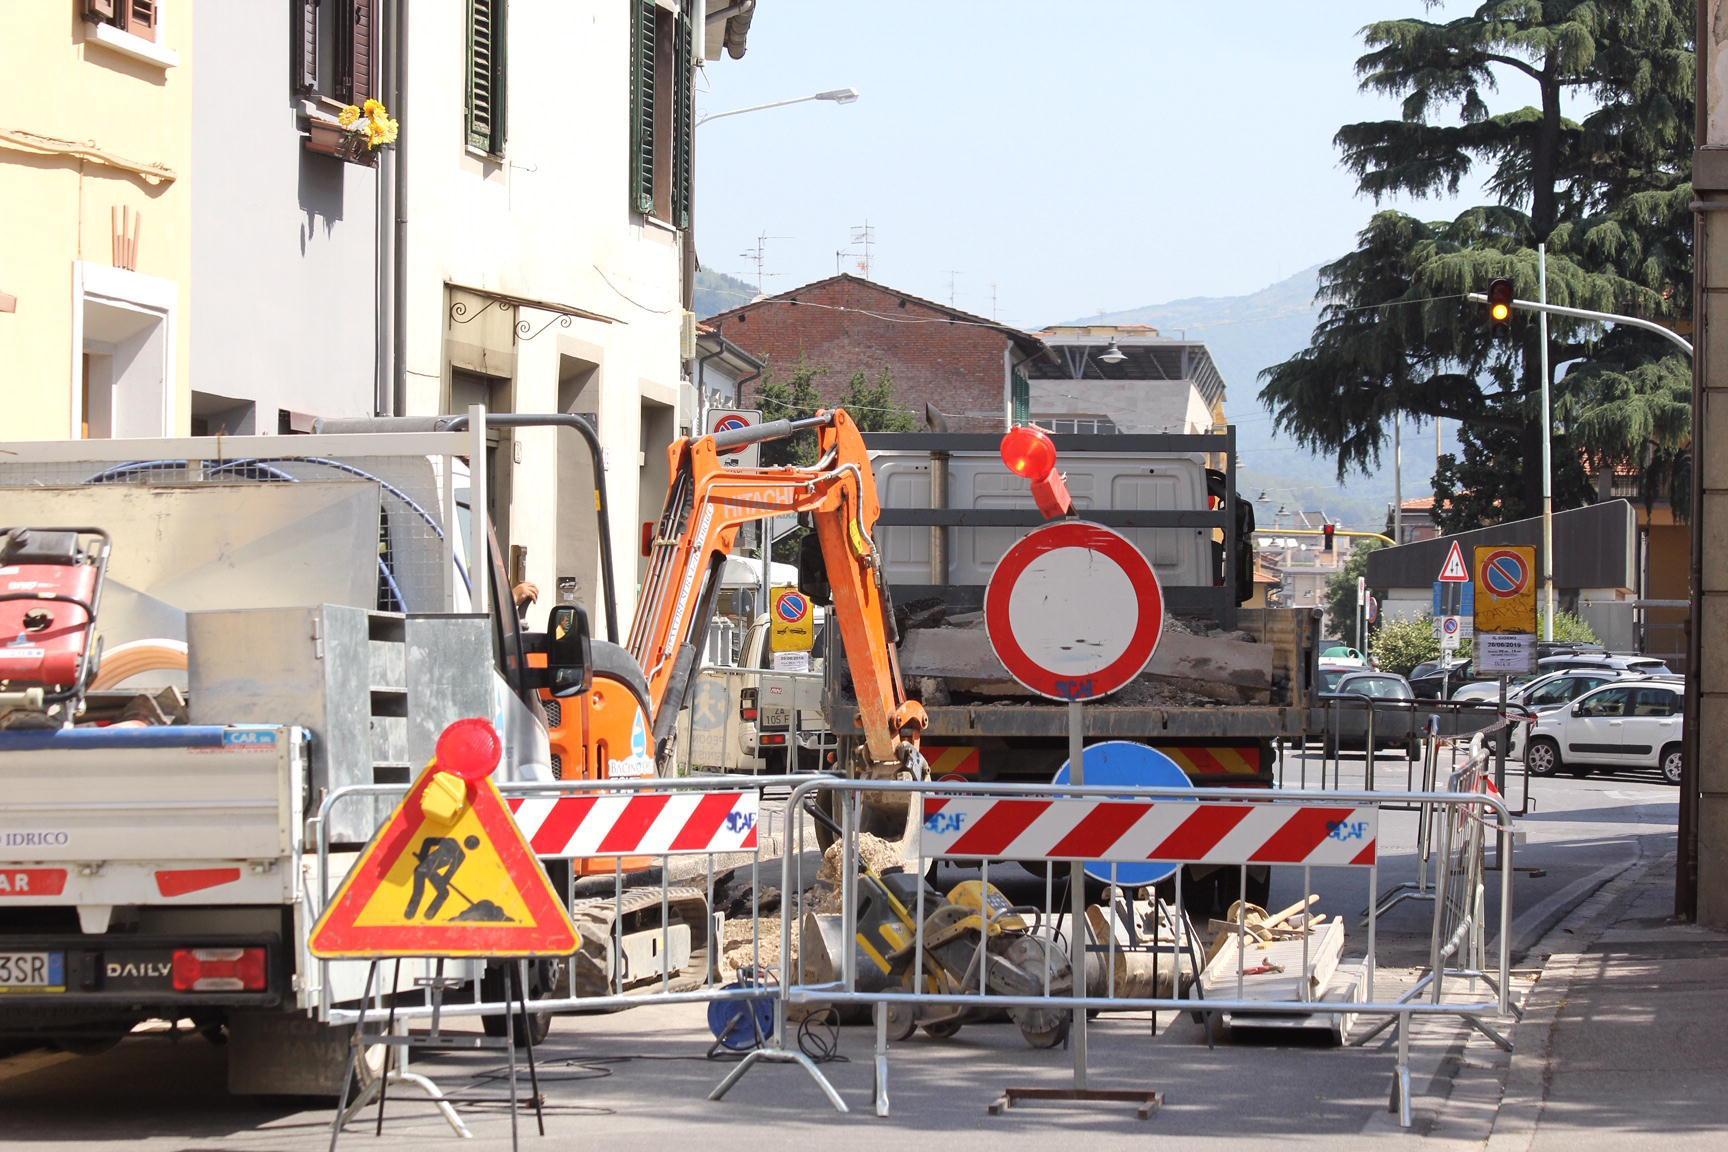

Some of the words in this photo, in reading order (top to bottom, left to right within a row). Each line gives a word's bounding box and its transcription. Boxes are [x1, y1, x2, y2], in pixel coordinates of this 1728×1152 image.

[230, 733, 257, 743] CAR
[6, 831, 69, 846] IDRICO
[106, 963, 172, 977] DAILY
